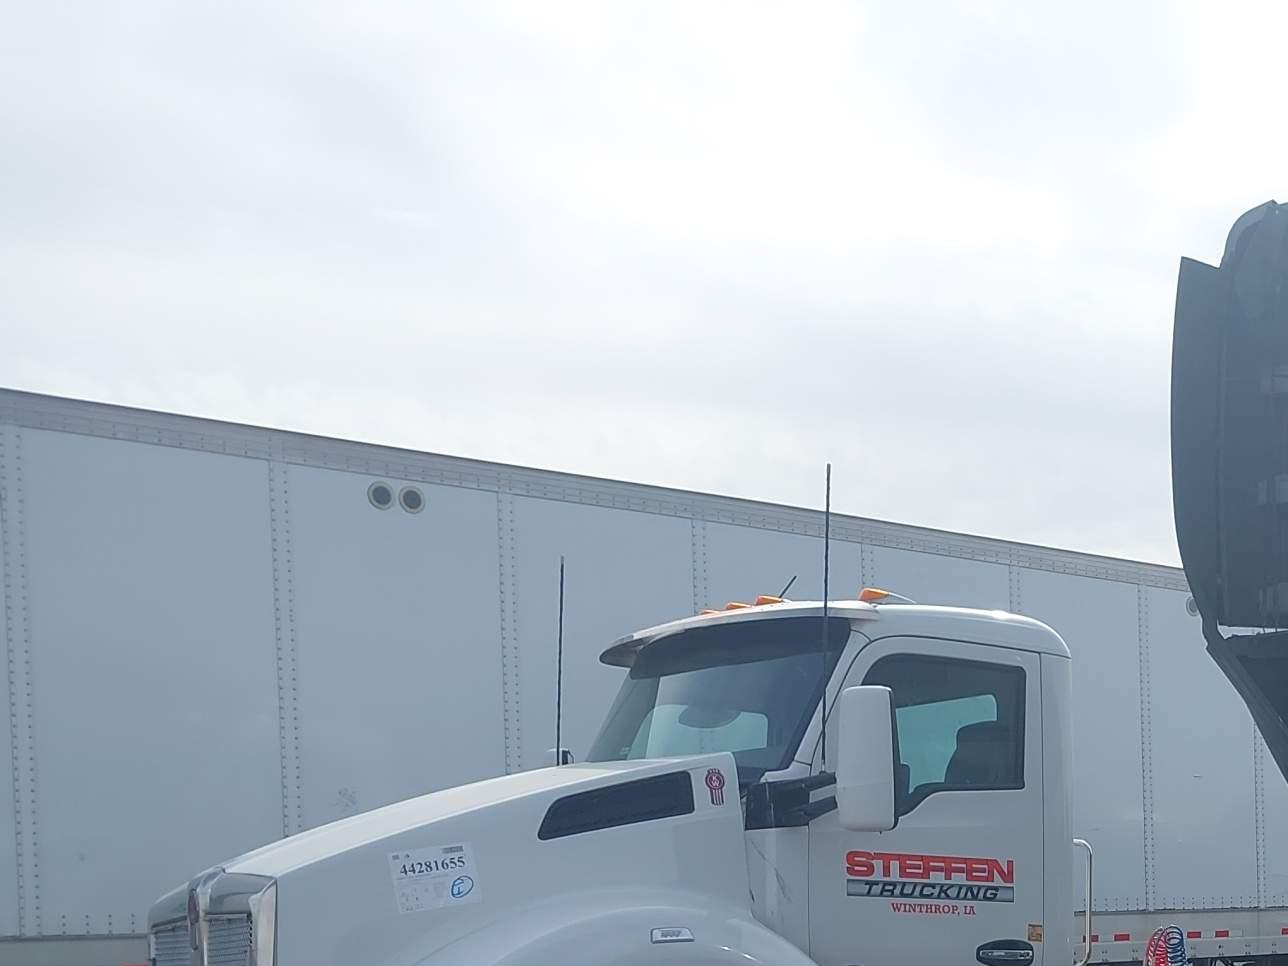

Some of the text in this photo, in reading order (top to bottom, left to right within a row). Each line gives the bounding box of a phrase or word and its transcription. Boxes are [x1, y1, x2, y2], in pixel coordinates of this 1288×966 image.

[399, 856, 466, 876] 44281655
[846, 850, 1015, 884] STEFFEN
[863, 881, 1001, 901] TRUCKING
[890, 903, 977, 916] WINTHROP, IA
